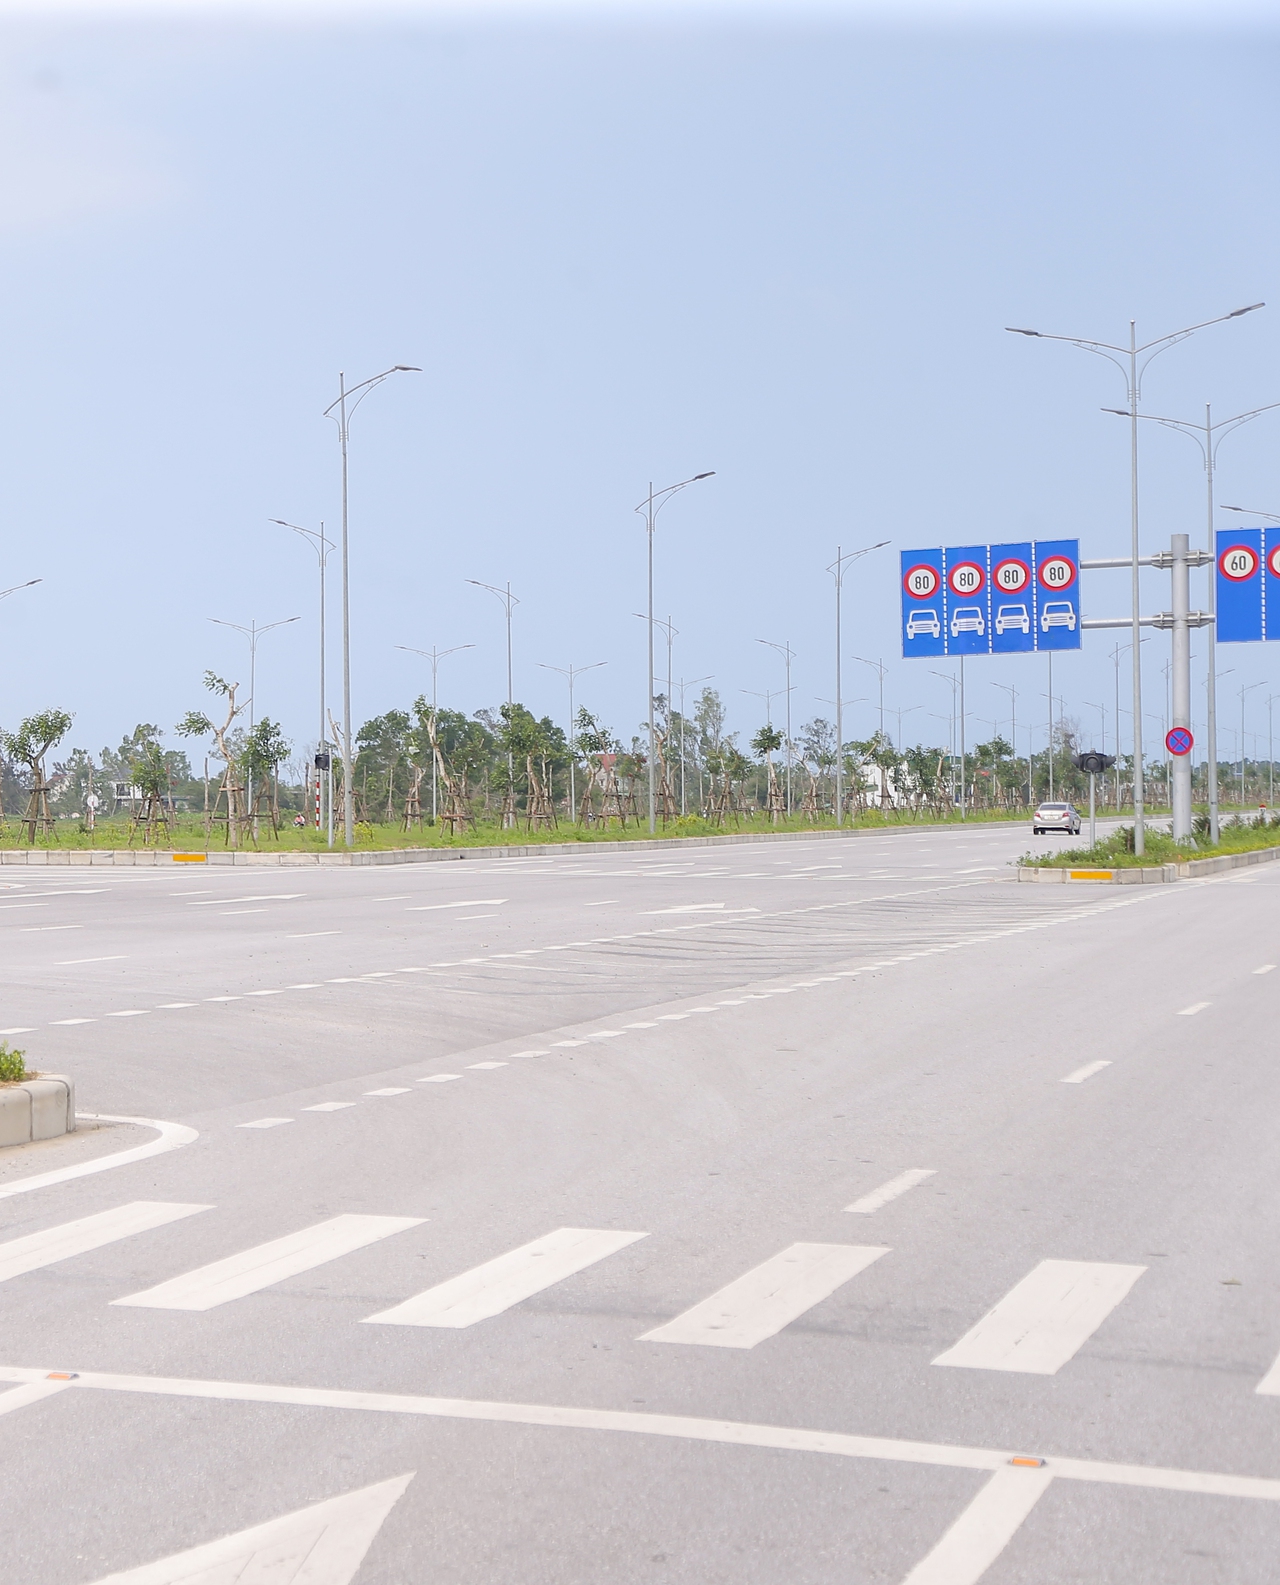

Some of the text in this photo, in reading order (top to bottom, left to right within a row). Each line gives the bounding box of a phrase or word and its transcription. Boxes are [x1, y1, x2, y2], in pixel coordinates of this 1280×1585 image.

[1231, 555, 1246, 571] 60
[959, 572, 974, 587] 80
[1004, 569, 1019, 584] 80
[1049, 566, 1064, 581] 80
[915, 575, 929, 590] 80
